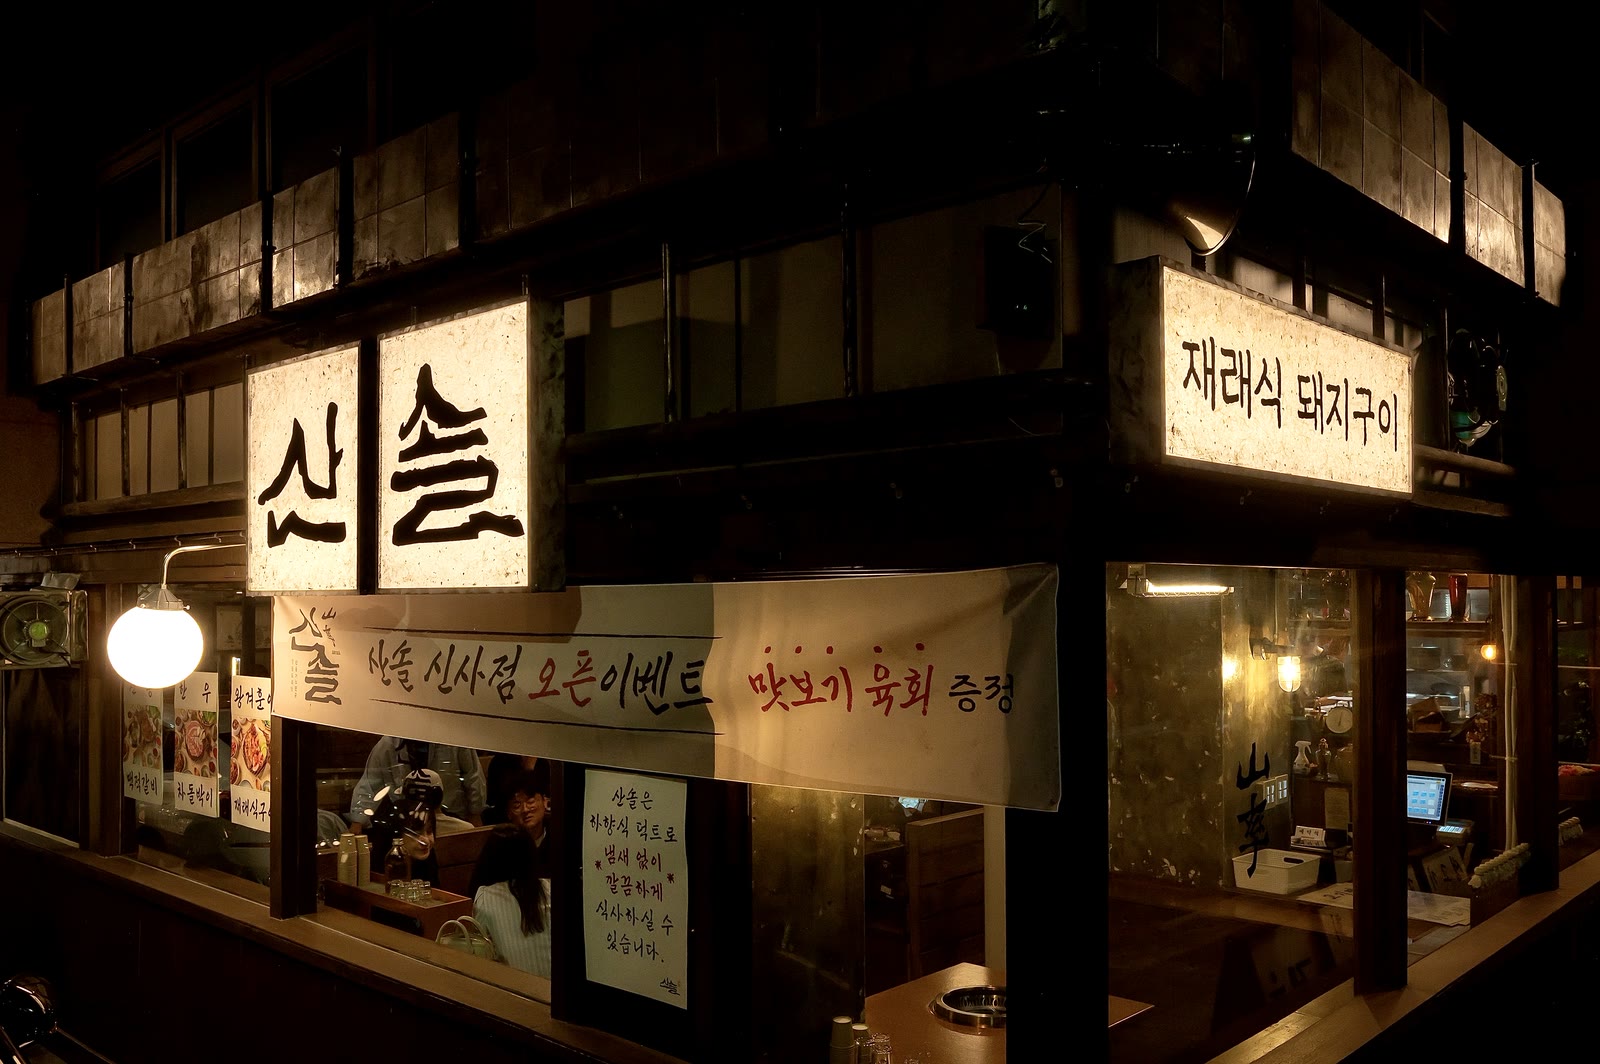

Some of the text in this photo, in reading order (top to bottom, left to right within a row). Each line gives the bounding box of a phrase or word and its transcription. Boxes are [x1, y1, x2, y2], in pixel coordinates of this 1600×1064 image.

[1182, 336, 1398, 452] 재래식 돼지구이
[368, 639, 414, 693] 산솔
[424, 643, 523, 705] 신사점
[748, 662, 853, 713] 맛보기
[865, 663, 934, 717] 육회
[949, 673, 1015, 714] 증정
[177, 781, 214, 809] 차돌박이
[589, 813, 678, 843] 하향식 덕트로
[604, 843, 662, 873] 냄새 없이
[605, 871, 663, 903] 깔끔하게
[595, 899, 674, 936] 식사하실 수
